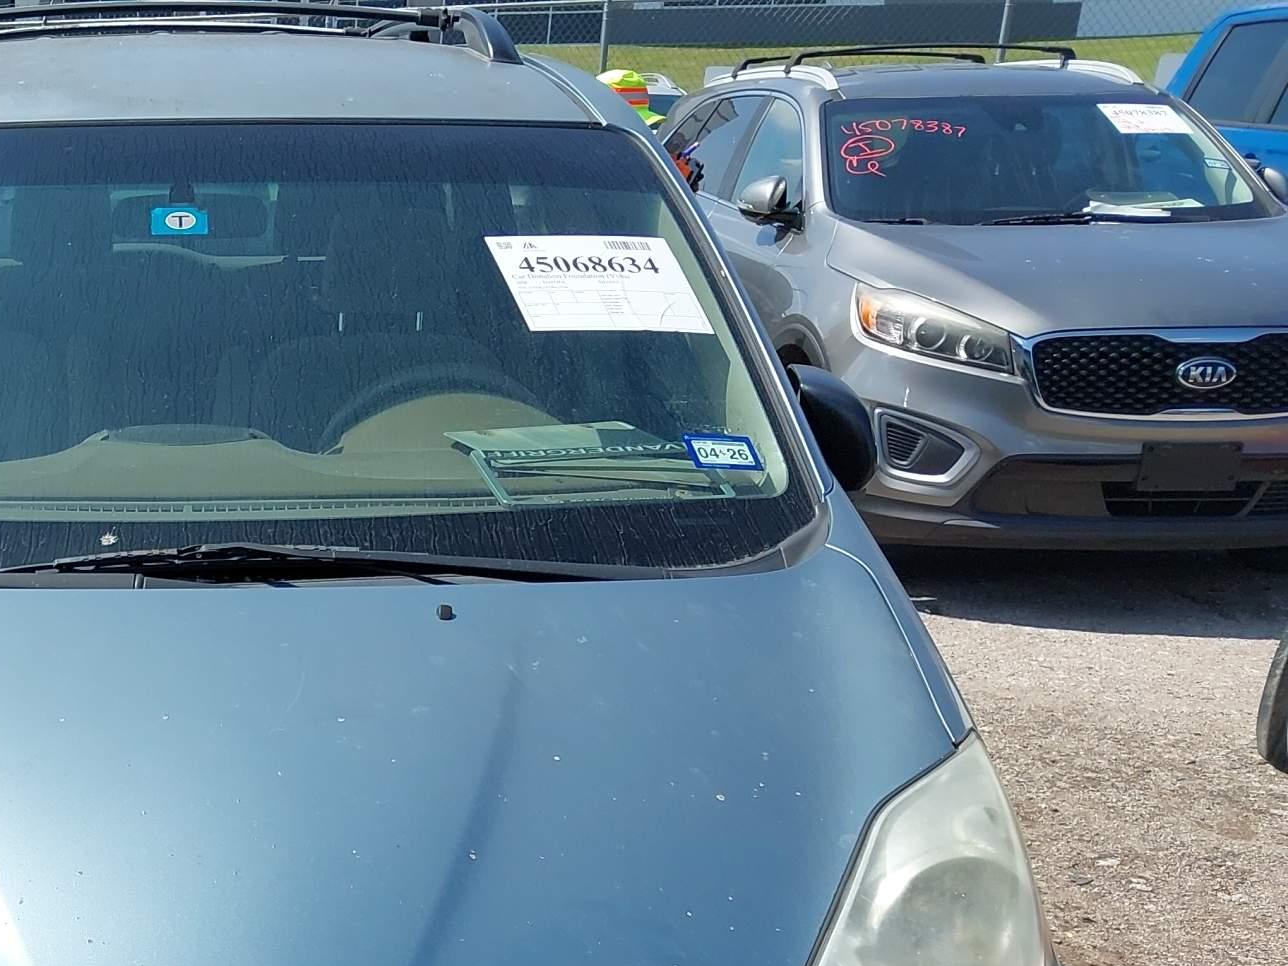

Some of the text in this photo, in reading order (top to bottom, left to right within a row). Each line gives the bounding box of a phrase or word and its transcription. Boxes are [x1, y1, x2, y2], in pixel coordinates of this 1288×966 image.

[840, 118, 966, 137] 45078387
[518, 255, 660, 275] 45068634
[1188, 366, 1228, 383] KIA
